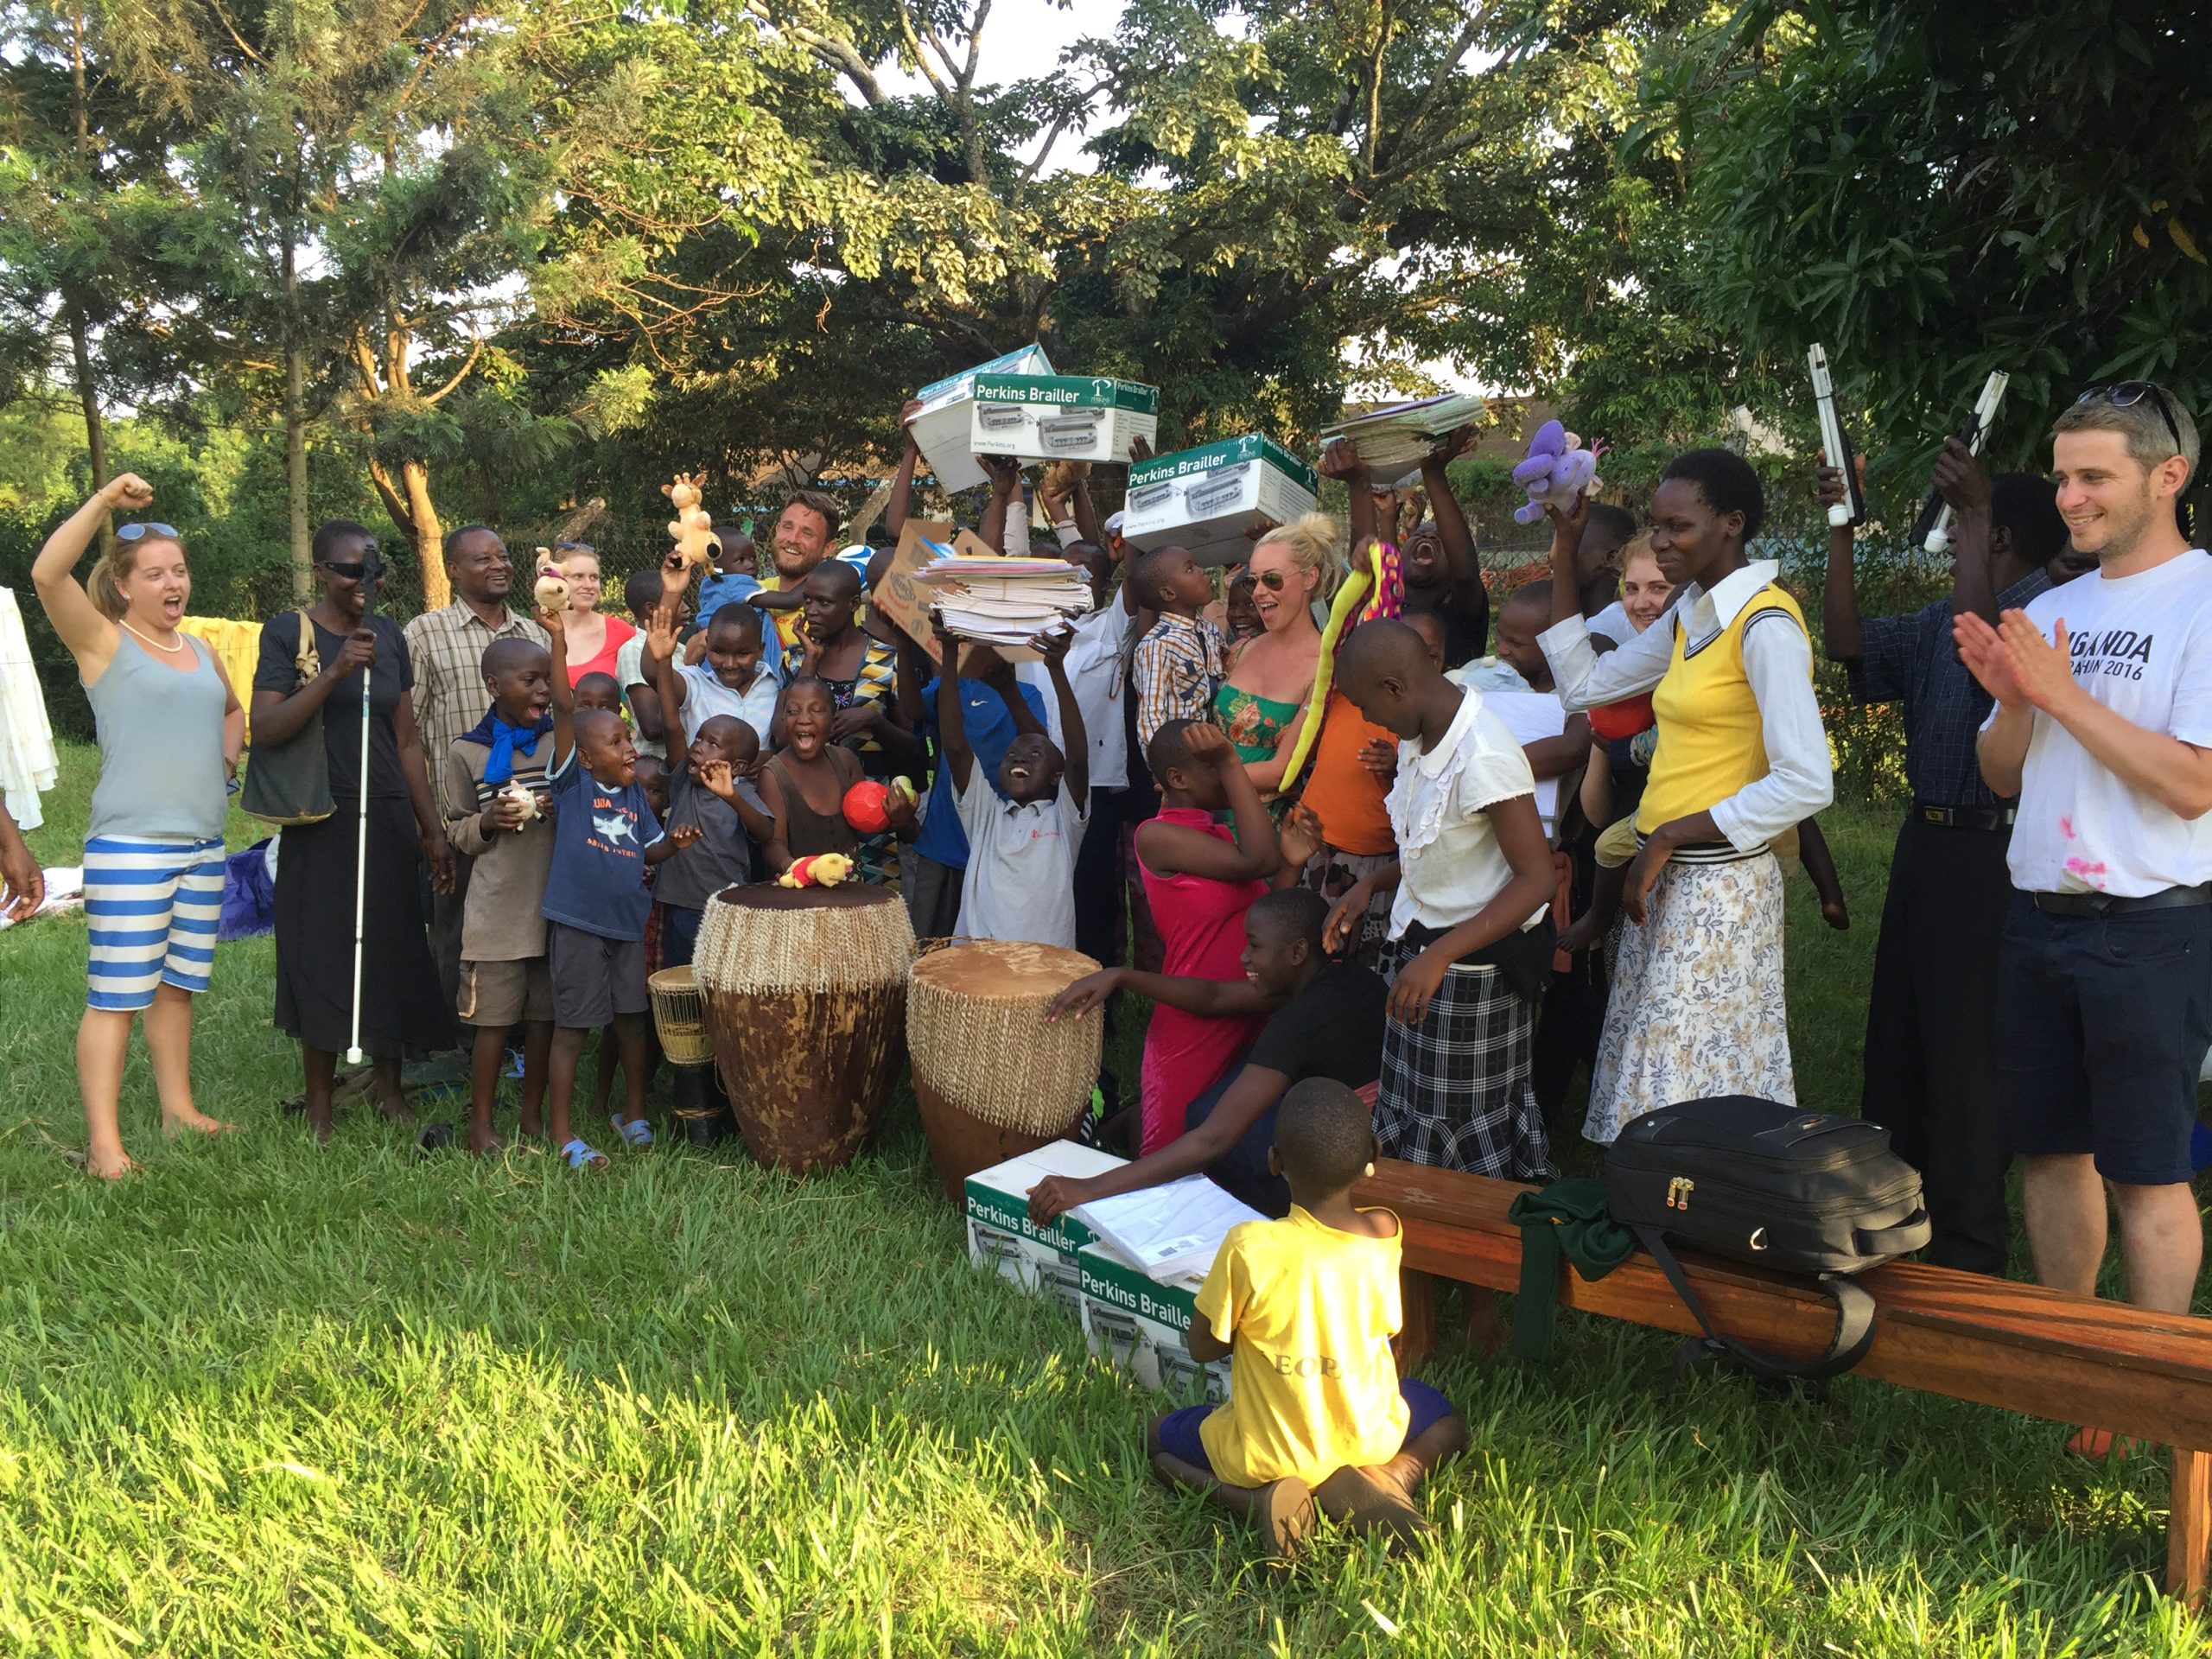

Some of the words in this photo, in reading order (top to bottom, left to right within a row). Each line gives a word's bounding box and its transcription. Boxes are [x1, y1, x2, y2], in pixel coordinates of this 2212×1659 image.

[918, 375, 959, 398] Perkins
[976, 385, 1026, 400] Perkins
[1029, 387, 1080, 404] Brailler
[1128, 467, 1175, 486] Perkins
[1178, 454, 1227, 474] Brailler
[2103, 660, 2144, 681] 2016
[967, 1196, 1020, 1231] Perkins
[1021, 1217, 1077, 1253] Brailler
[1081, 1269, 1137, 1309] Perkins
[1140, 1292, 1192, 1331] Braille
